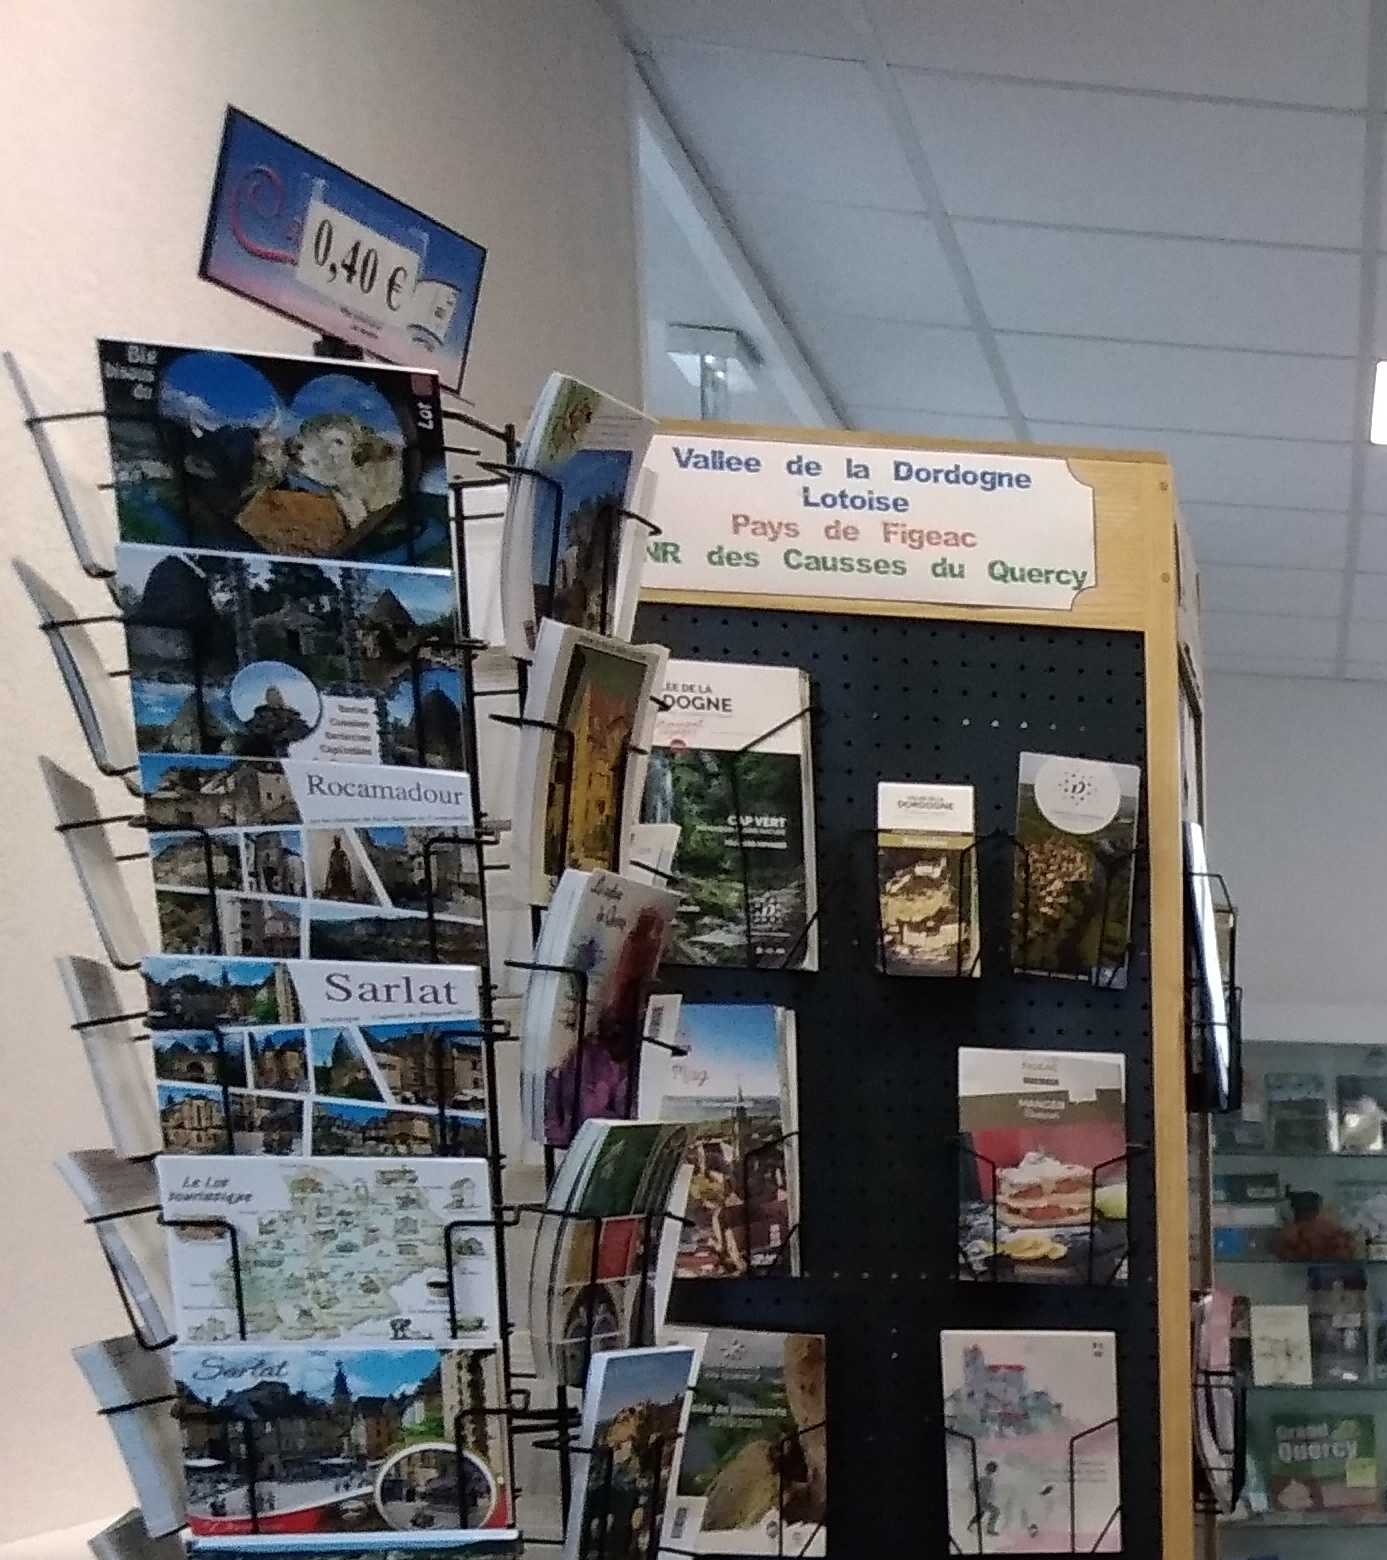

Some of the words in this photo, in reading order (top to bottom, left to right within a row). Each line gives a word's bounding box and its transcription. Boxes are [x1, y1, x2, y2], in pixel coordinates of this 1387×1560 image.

[314, 218, 379, 294] 0,40
[386, 266, 408, 311] €
[672, 446, 762, 473] Vallee
[786, 457, 822, 477] de
[846, 458, 871, 480] la
[893, 461, 1033, 490] Dordogne
[802, 487, 911, 513] Lotoise
[731, 513, 800, 541] Pays
[825, 519, 860, 541] de
[882, 521, 978, 550] Figeac
[707, 548, 760, 568] des
[783, 548, 908, 577] Causses
[931, 557, 966, 580] du
[987, 560, 1088, 590] Quercy
[306, 773, 464, 805] Rocamadour
[754, 816, 787, 828] VERT
[325, 972, 458, 1005] Sarlat
[193, 1356, 289, 1381] Sarlat
[1278, 1441, 1358, 1462] Quercy
